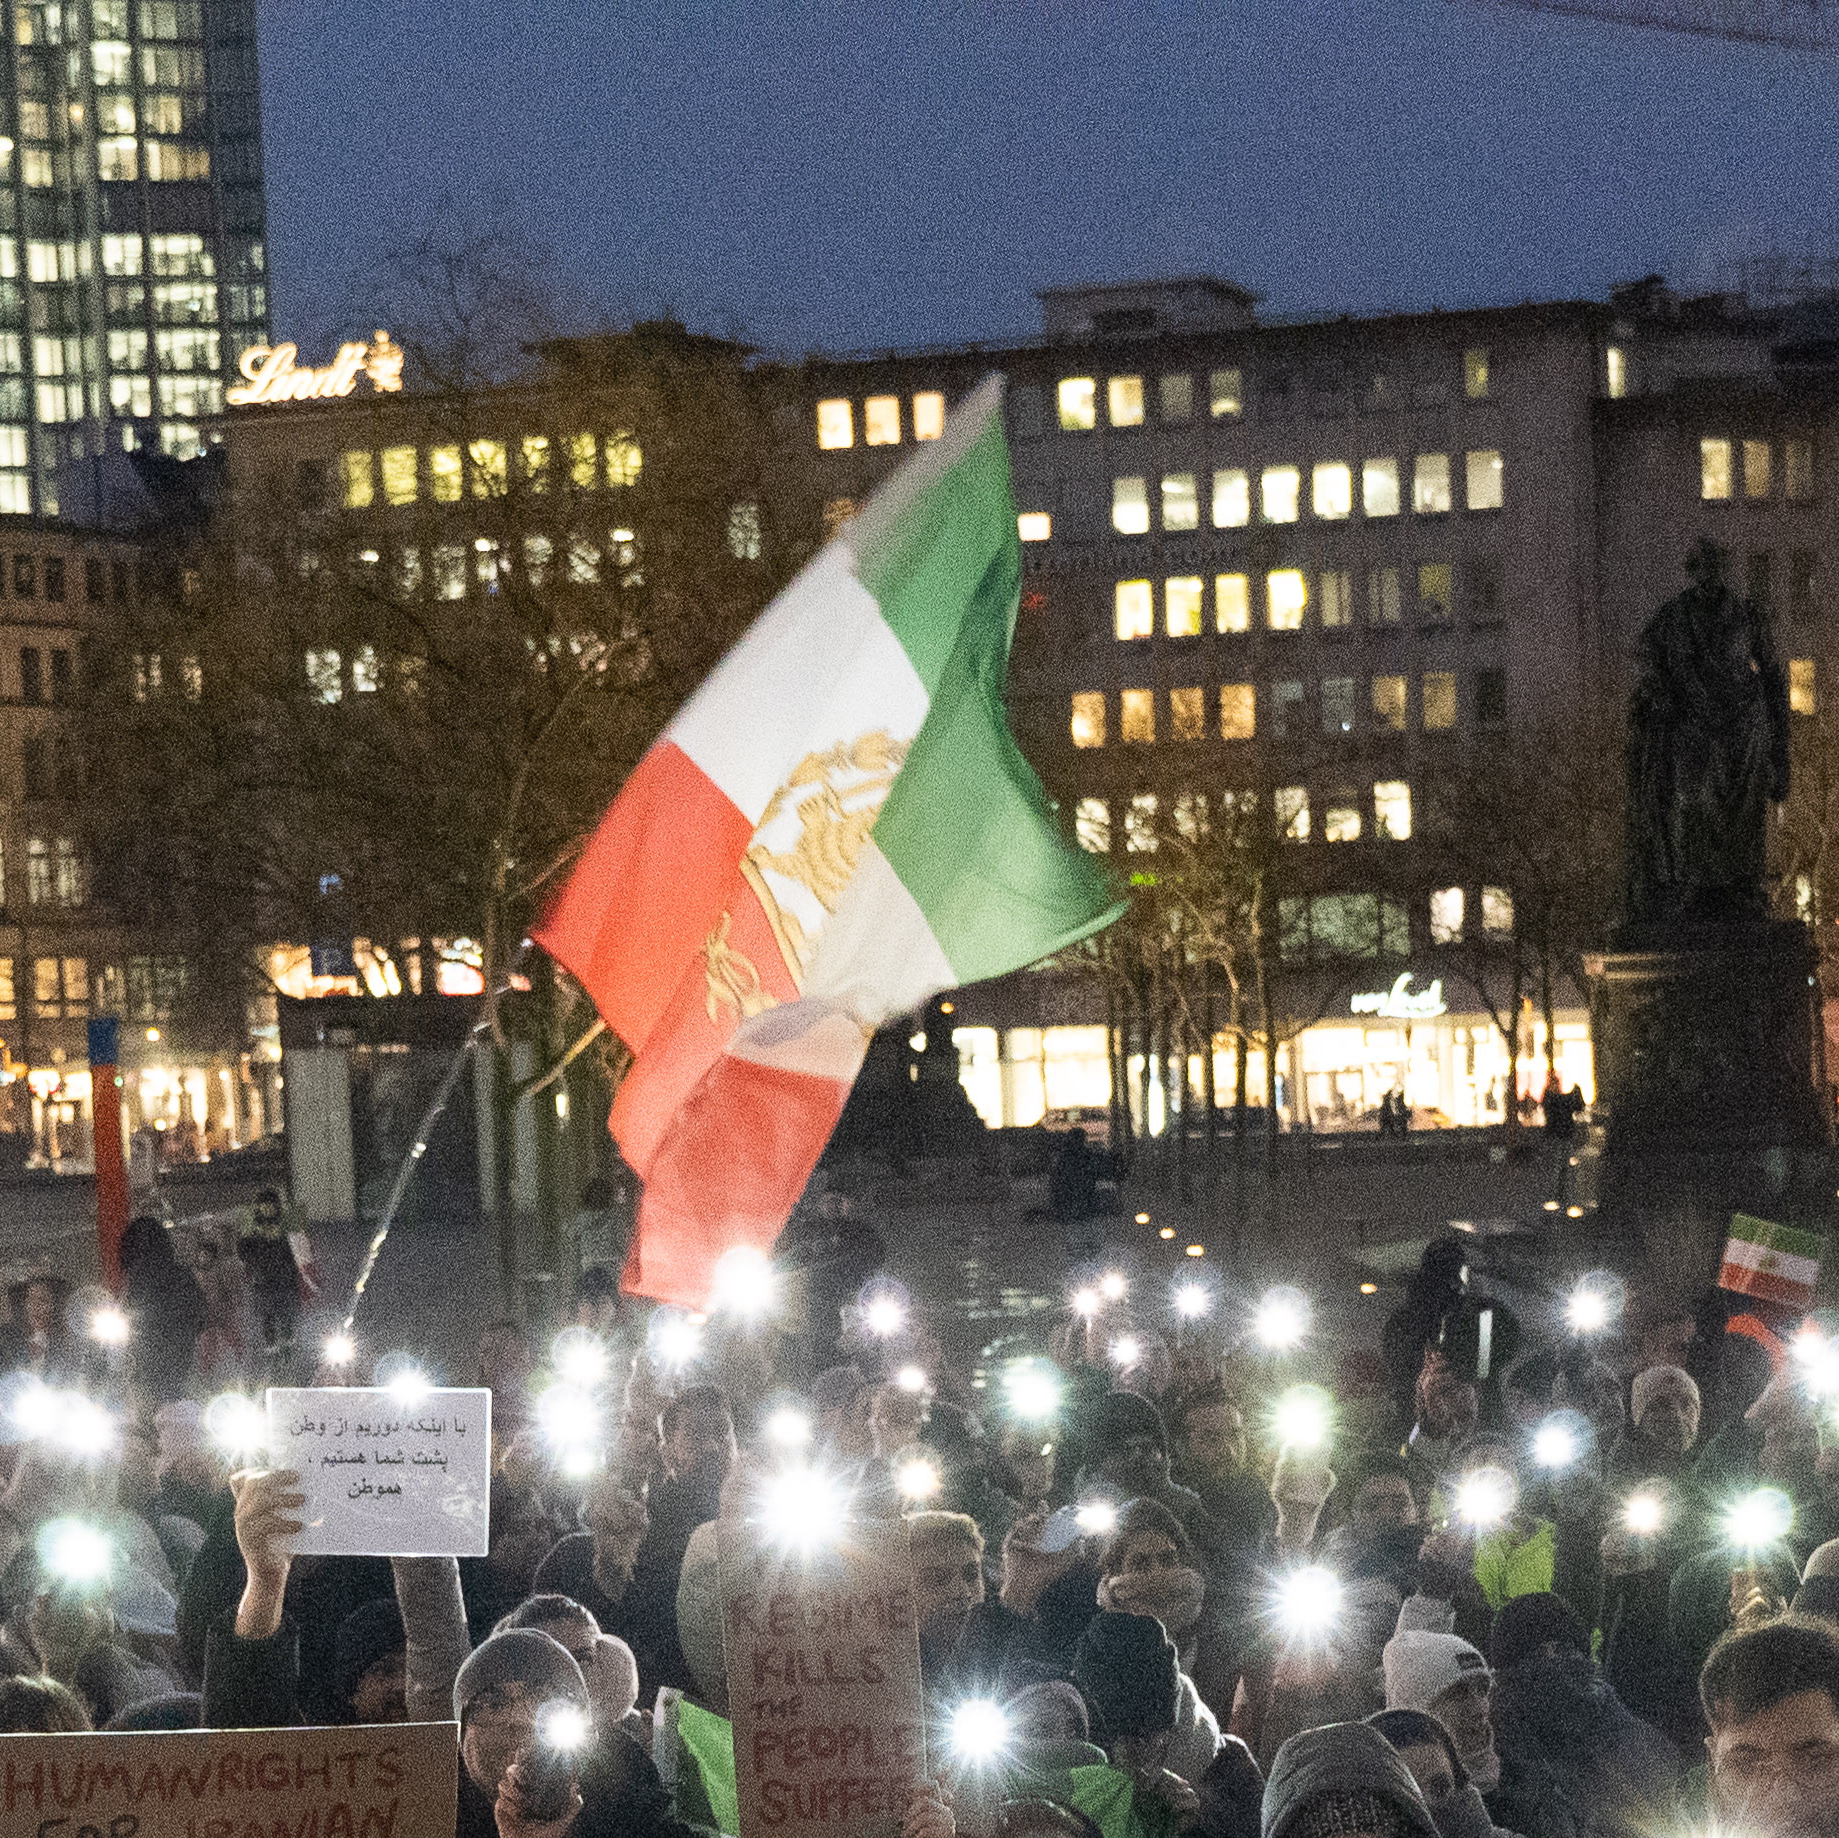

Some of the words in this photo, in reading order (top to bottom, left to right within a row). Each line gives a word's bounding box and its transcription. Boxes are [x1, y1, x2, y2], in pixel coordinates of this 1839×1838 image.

[289, 1414, 327, 1437] وطن
[334, 1415, 349, 1438] از
[355, 1420, 400, 1439] دوریم
[406, 1418, 447, 1438] اینکه
[453, 1416, 467, 1438] با
[374, 1448, 405, 1467] شما
[411, 1448, 449, 1474] پشت
[751, 1647, 887, 1687] KILLS
[752, 1697, 803, 1721] THE
[752, 1724, 917, 1774] PEOPLE
